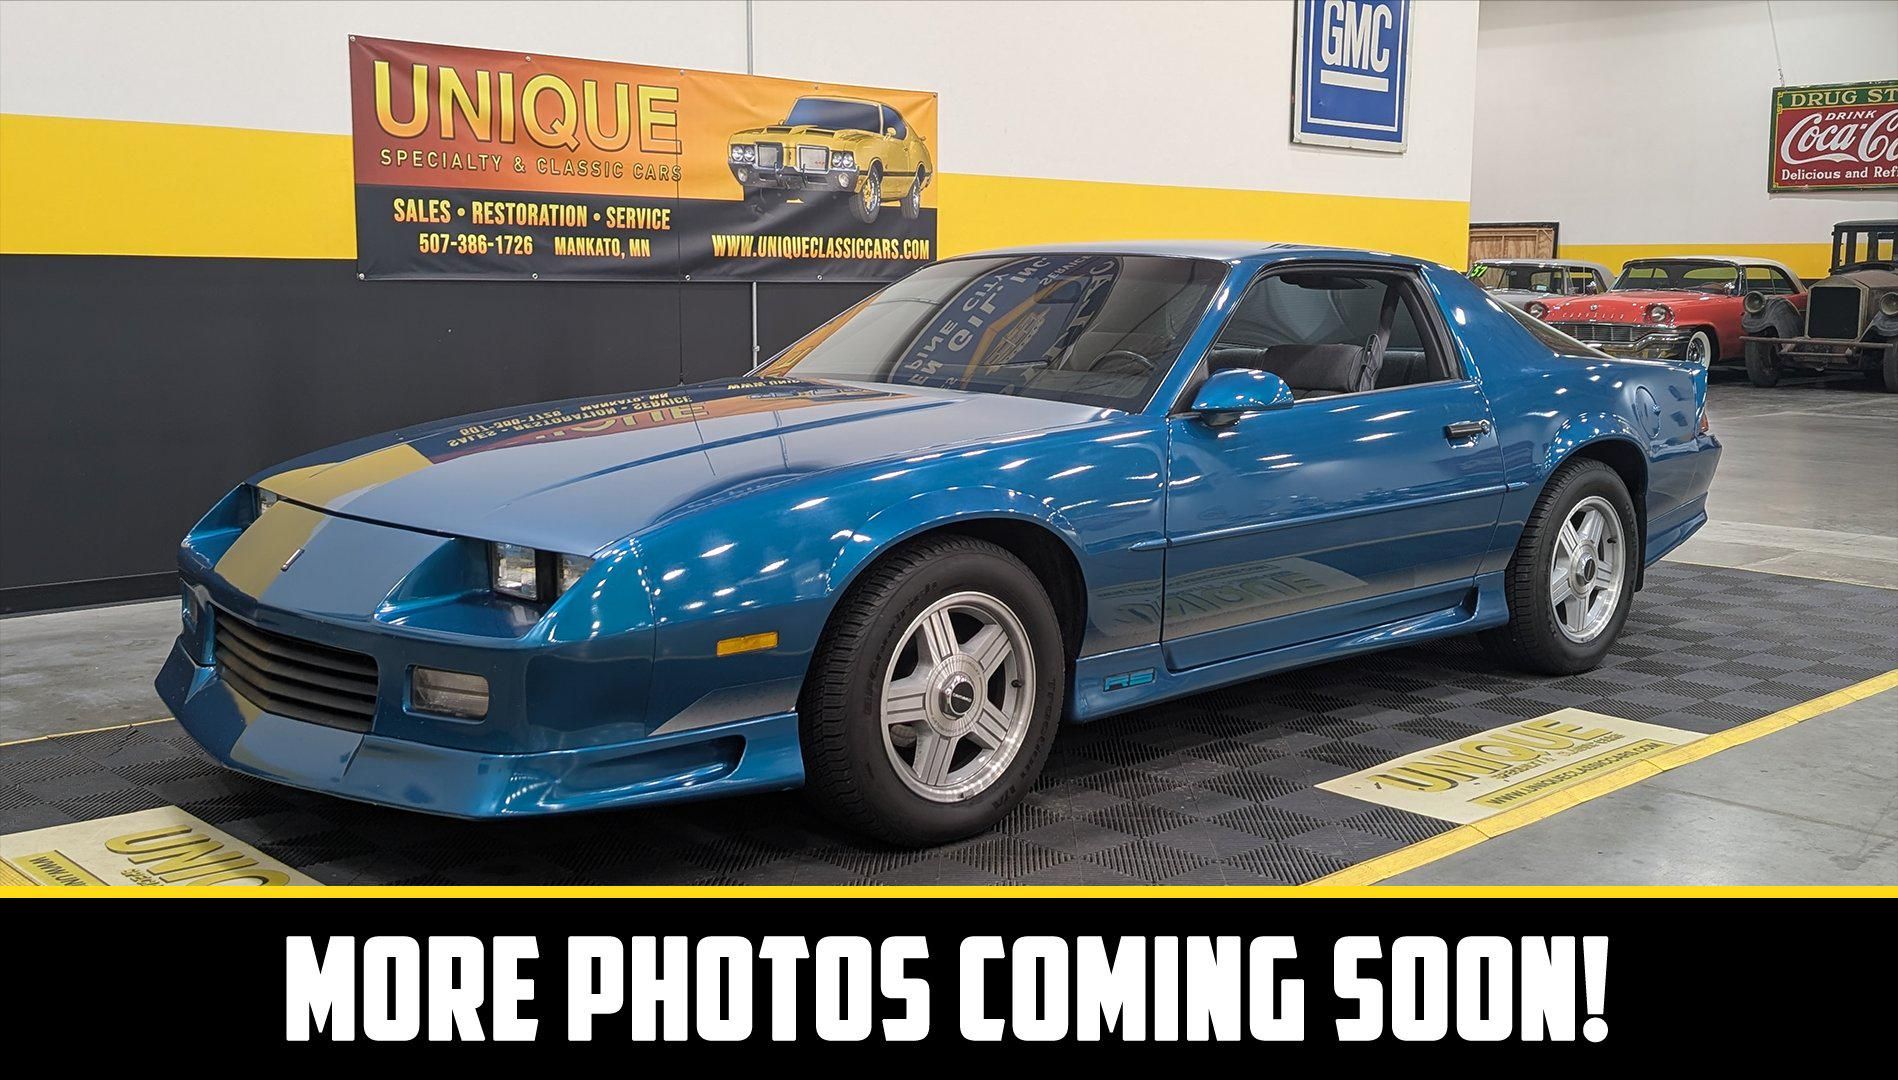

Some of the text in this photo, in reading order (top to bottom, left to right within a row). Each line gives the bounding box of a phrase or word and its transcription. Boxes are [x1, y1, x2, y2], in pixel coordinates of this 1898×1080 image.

[1321, 0, 1392, 73] GMC
[373, 60, 683, 155] UNIQUE
[1791, 90, 1857, 107] DRUG
[1825, 109, 1877, 121] DRINK
[380, 148, 683, 182] SPECIALTY & CLASSIC CARS
[1781, 168, 1841, 180] Delicious
[1845, 167, 1868, 179] and
[393, 197, 671, 231] SALES RESTORATION SERVICE
[419, 232, 651, 260] 507-386-1726 MANKATO, MN
[711, 234, 930, 260] WWW.UNIQUECLASSICCARS.COM
[1367, 718, 1615, 793] UNIQUE
